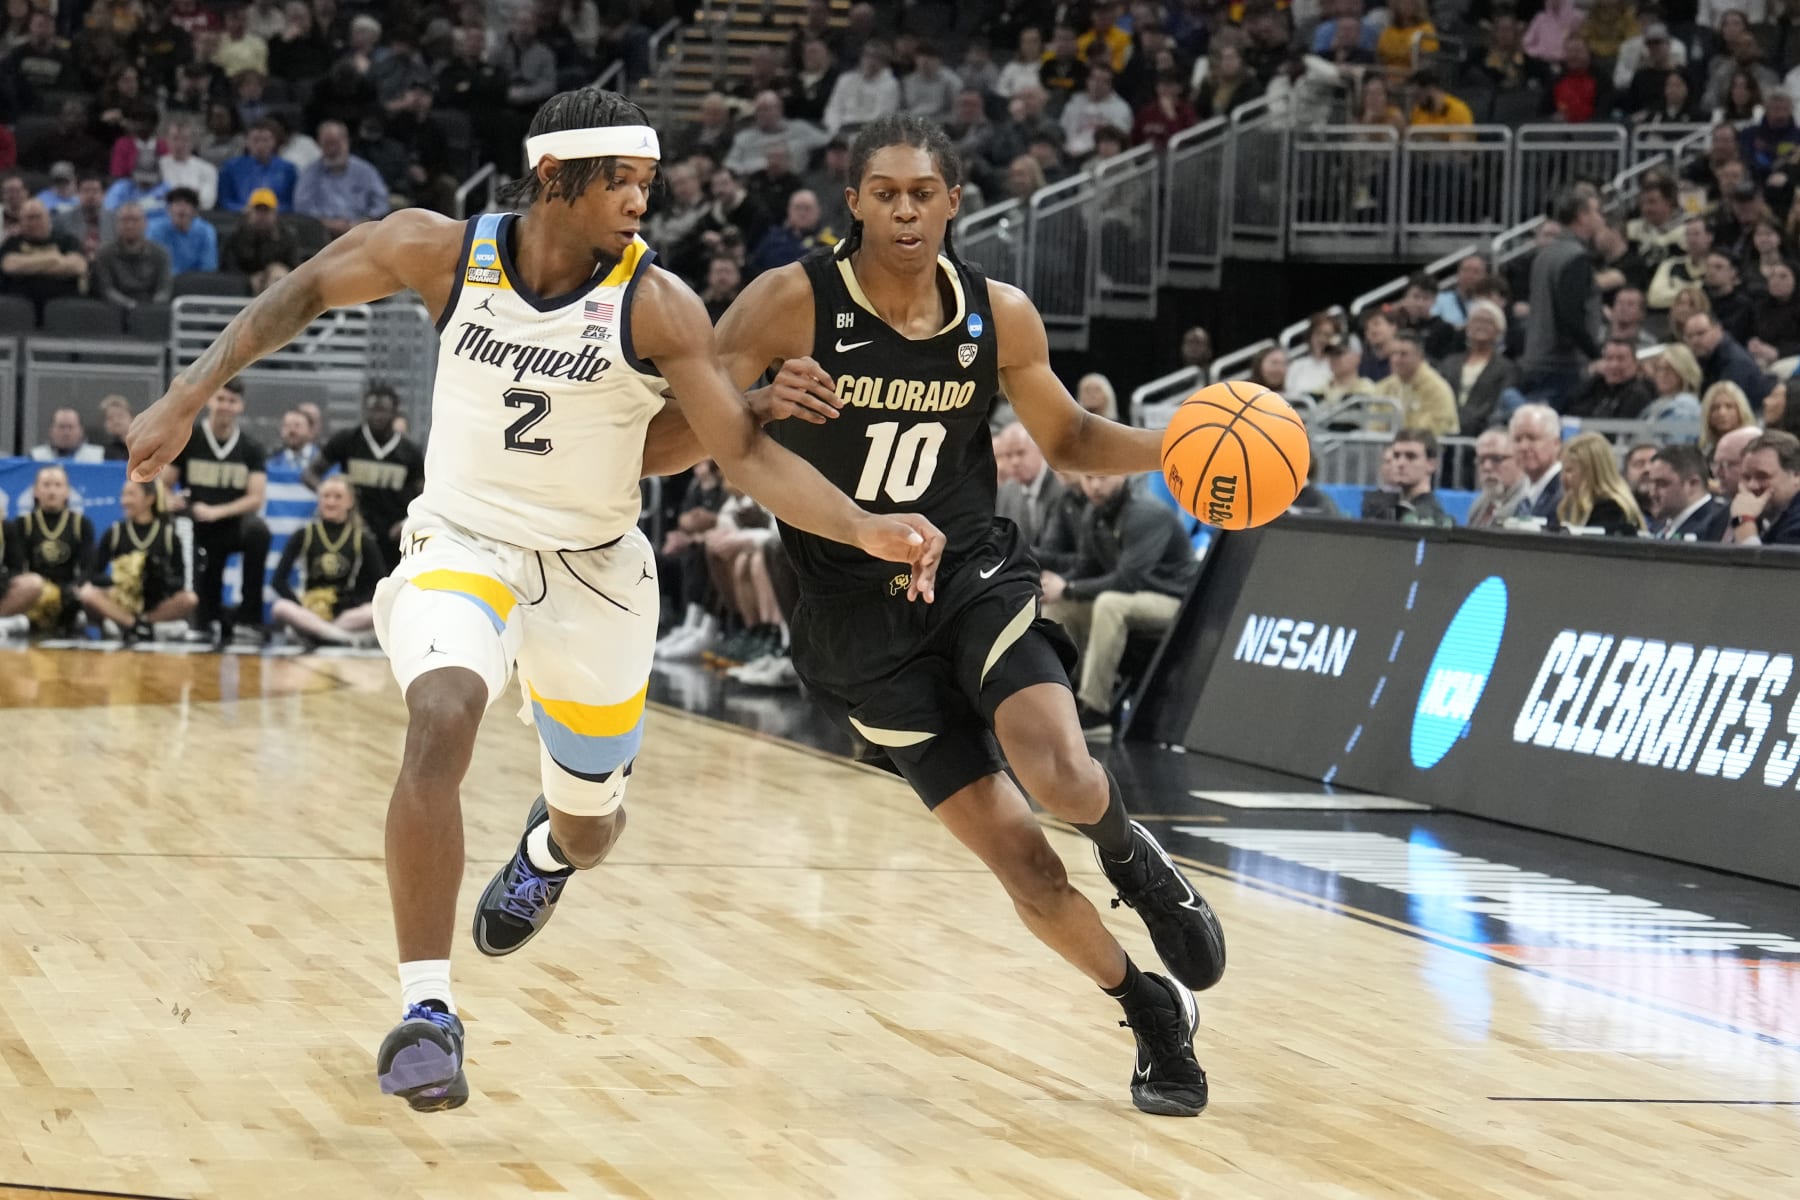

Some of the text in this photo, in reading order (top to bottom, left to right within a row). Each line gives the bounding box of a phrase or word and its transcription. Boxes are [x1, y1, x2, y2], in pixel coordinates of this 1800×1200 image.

[582, 330, 612, 340] EAST
[586, 324, 608, 333] BIG
[836, 312, 855, 329] BH
[453, 322, 613, 383] Marquette
[502, 387, 553, 455] 2
[834, 374, 976, 412] COLORADO
[854, 421, 948, 503] 10
[1209, 475, 1238, 527] Wils
[1233, 614, 1357, 677] NISSAN
[1513, 628, 1794, 779] CELEBRATES
